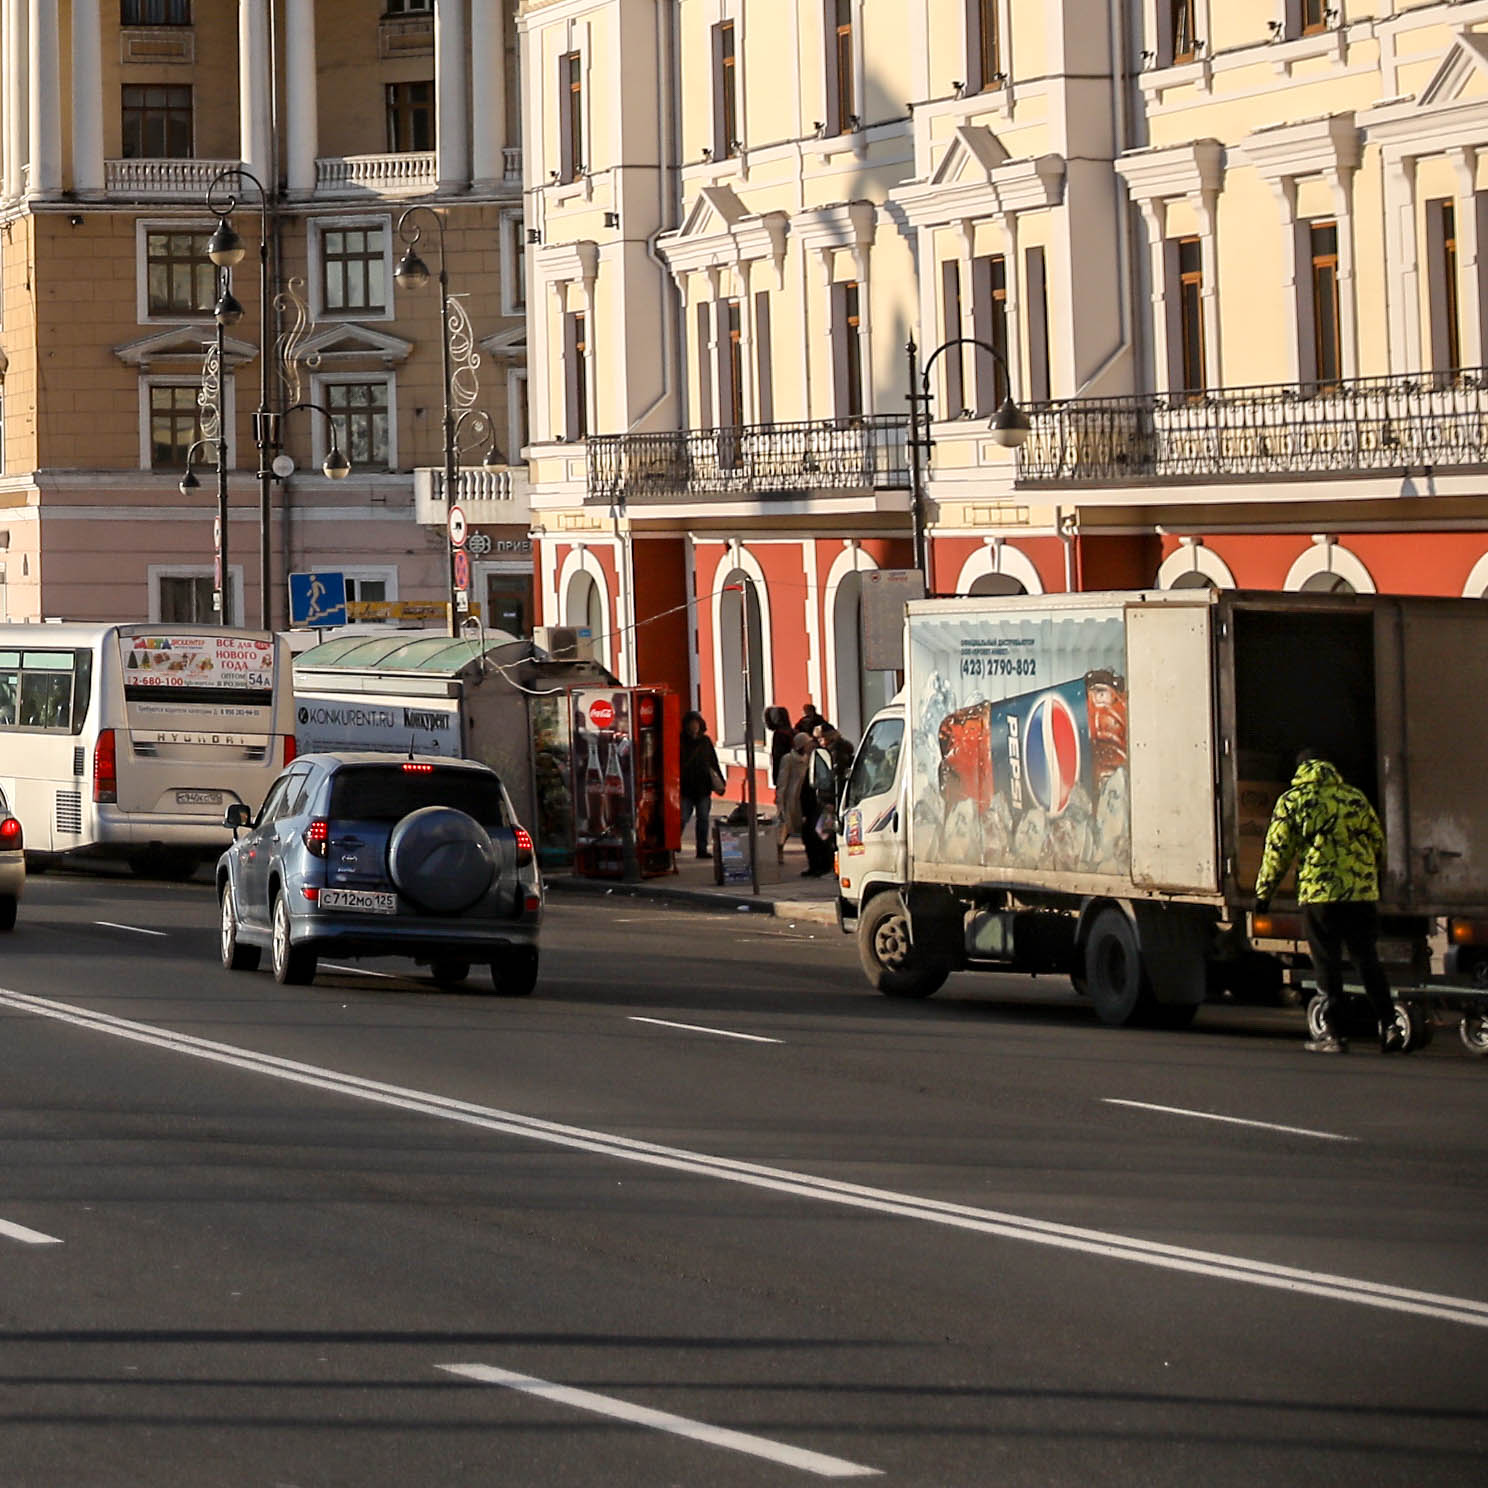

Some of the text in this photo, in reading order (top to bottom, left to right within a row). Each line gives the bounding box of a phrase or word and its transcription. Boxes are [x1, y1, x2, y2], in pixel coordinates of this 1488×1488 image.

[216, 639, 235, 648] ВСЕ
[216, 650, 257, 661] НОВОГО
[220, 660, 249, 671] ГОДА
[960, 658, 1036, 680] (423) 2790-802
[132, 676, 184, 686] 2-680-100
[310, 708, 394, 728] KONKURENT.RU
[403, 707, 449, 731] Конкурент
[1007, 715, 1023, 809] PEPSI
[324, 892, 393, 907] С712МО 125
